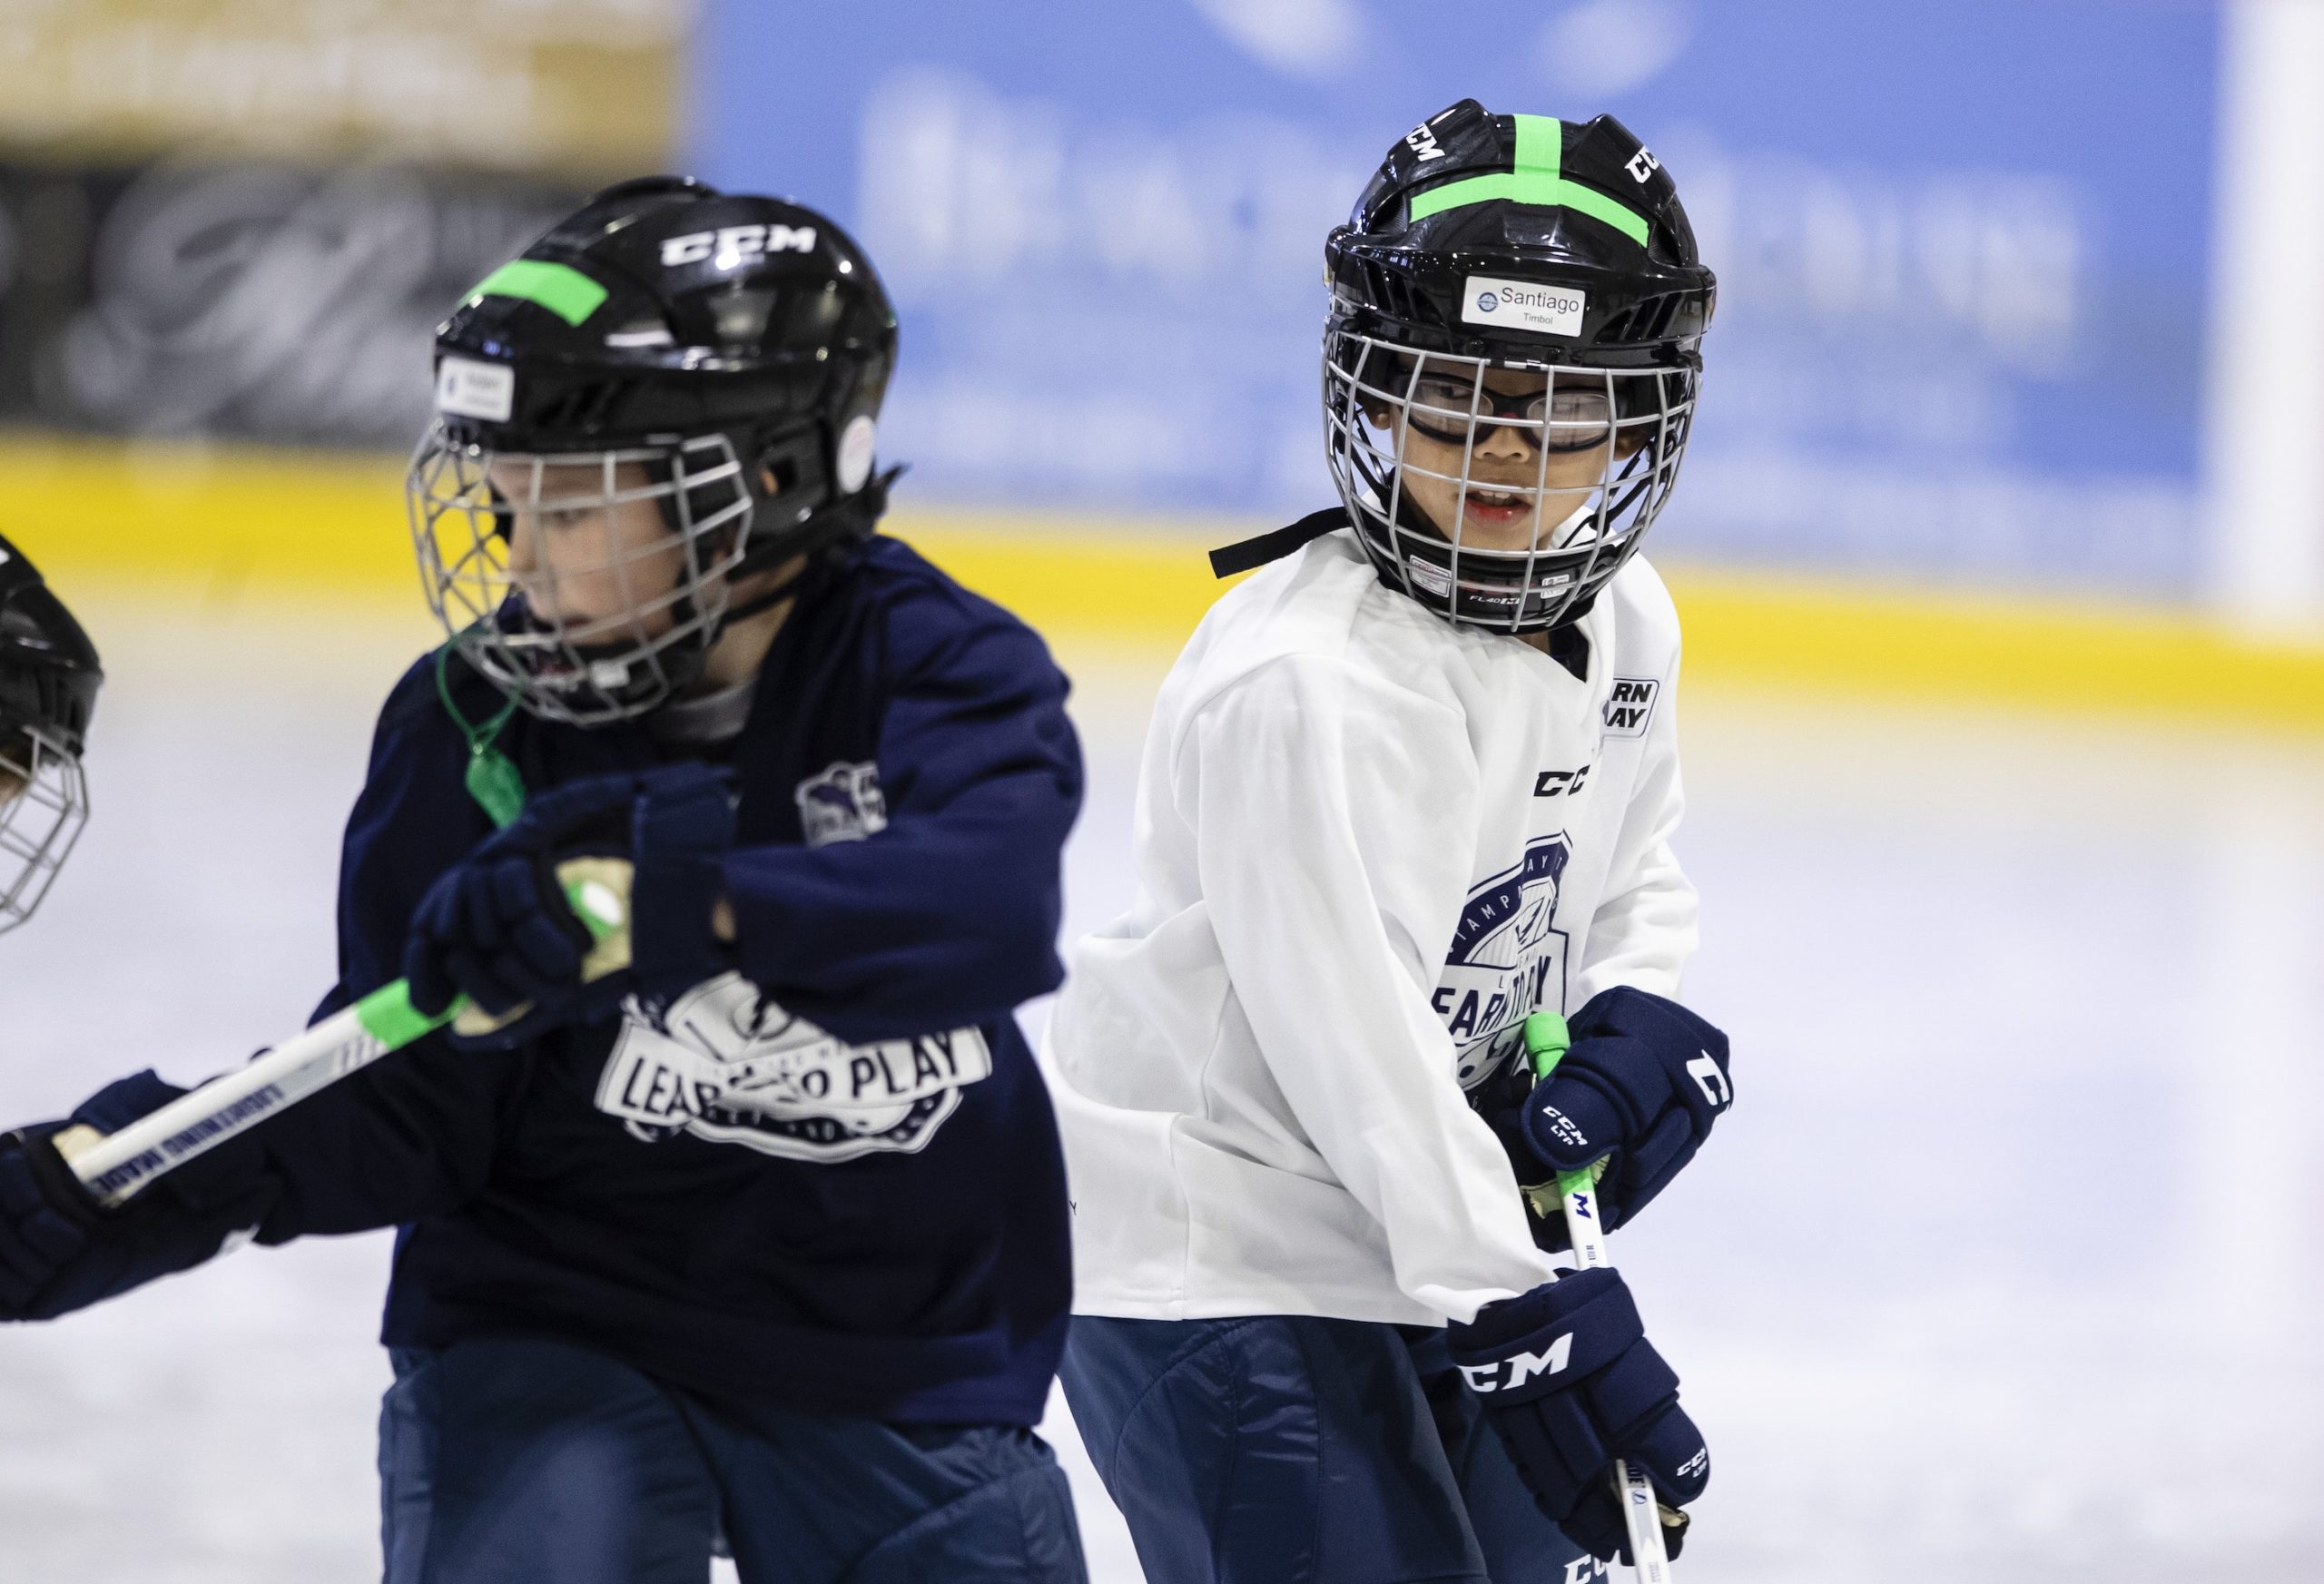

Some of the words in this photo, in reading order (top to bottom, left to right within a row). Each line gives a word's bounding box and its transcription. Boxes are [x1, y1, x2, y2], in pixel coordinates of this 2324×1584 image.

[1405, 122, 1446, 162] CM
[660, 224, 816, 267] CCM
[1501, 287, 1580, 315] Santiago
[1523, 312, 1553, 325] Timbol
[1611, 683, 1652, 703] RN
[1607, 707, 1647, 728] AY
[621, 1057, 723, 1118] LEAR
[851, 1033, 958, 1098] PLAY
[1542, 1106, 1588, 1146] CCM
